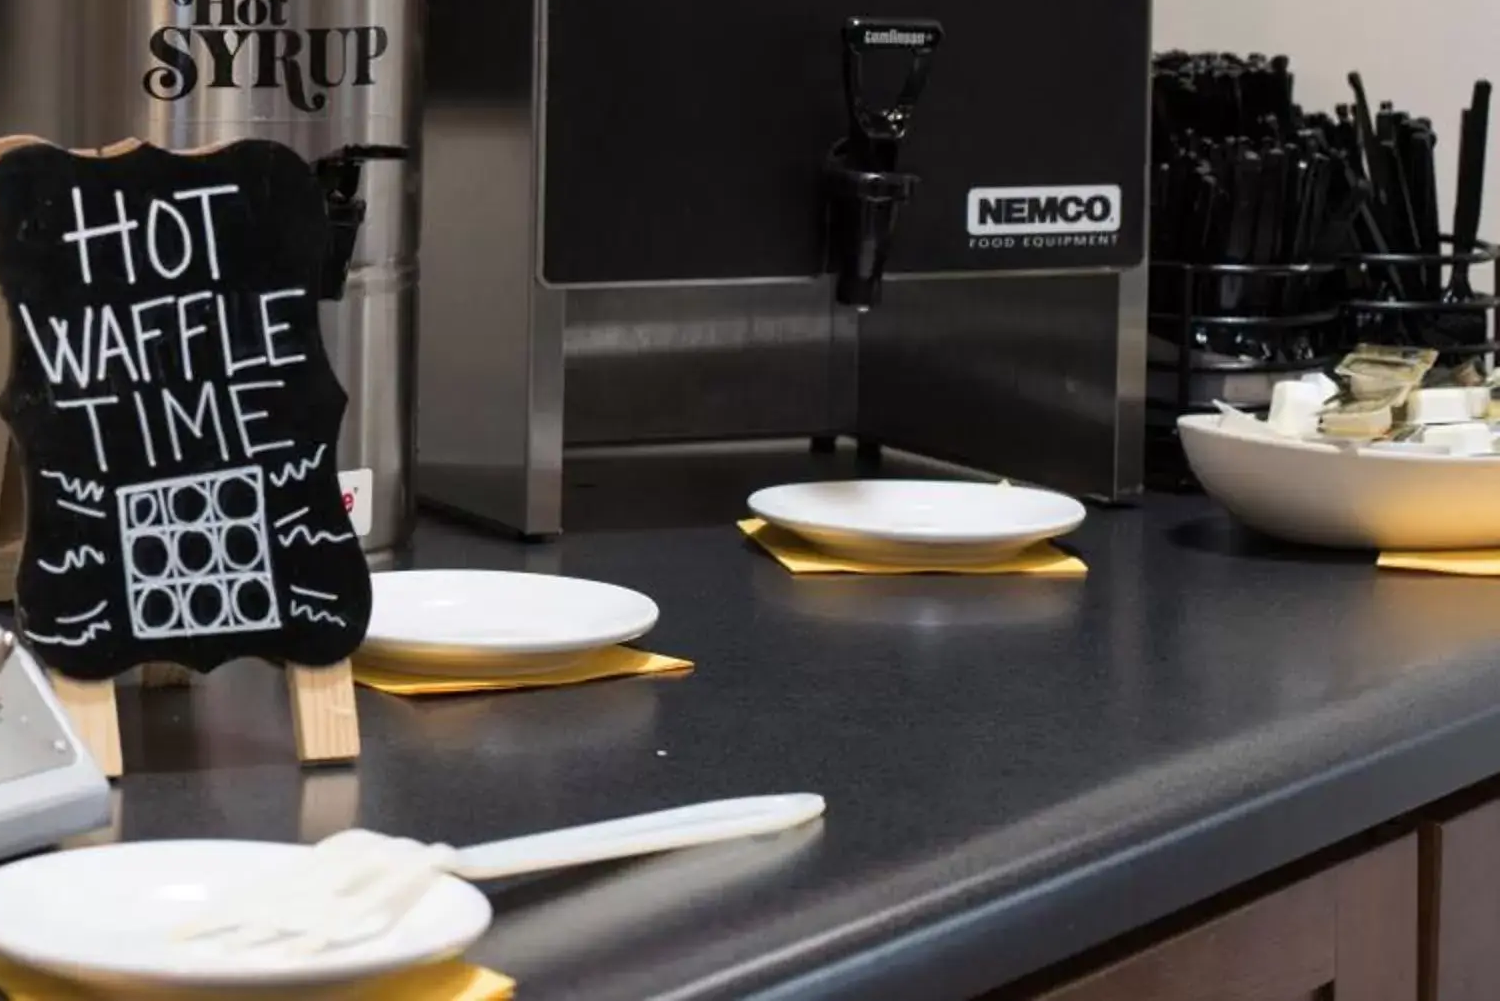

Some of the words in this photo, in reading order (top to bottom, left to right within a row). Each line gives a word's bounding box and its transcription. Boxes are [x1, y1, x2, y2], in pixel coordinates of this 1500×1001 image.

[143, 26, 388, 113] SYRUP
[63, 185, 239, 283] HOT
[969, 237, 1015, 249] FOOD
[1023, 234, 1119, 248] EQUIPMENT
[977, 196, 1112, 225] NEMCO
[19, 288, 306, 389] WAFFLE
[56, 380, 295, 472] TIME
